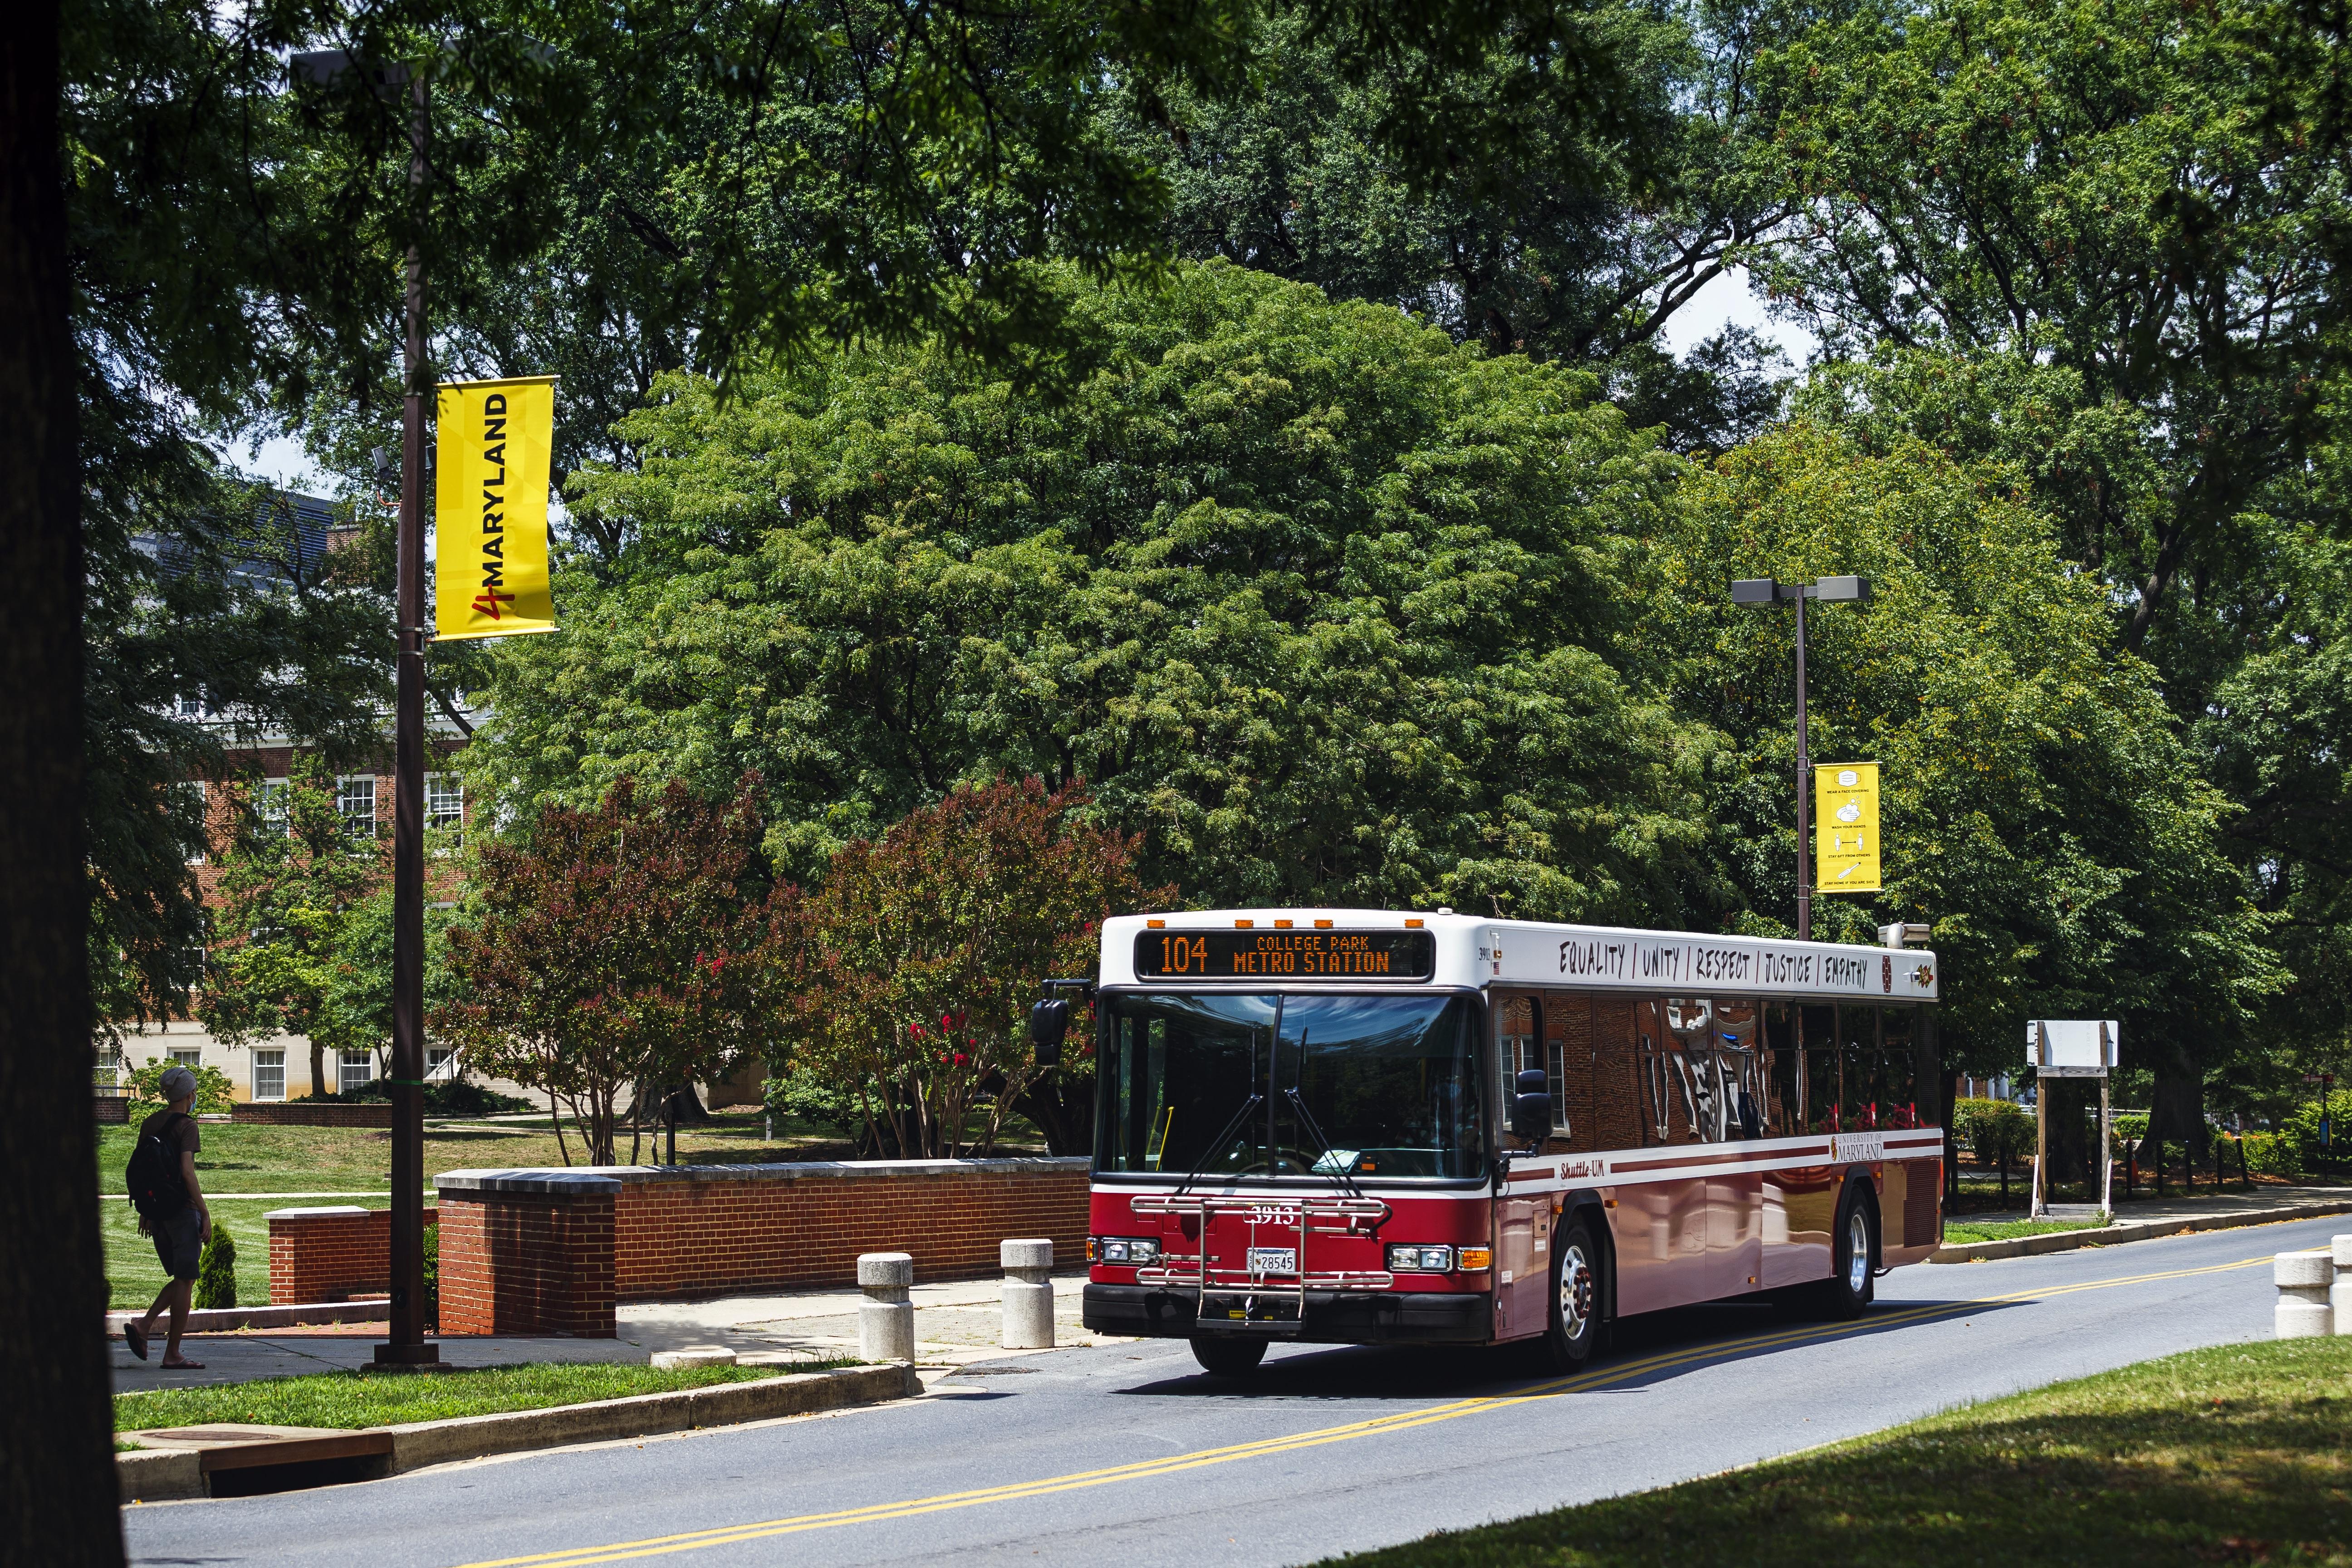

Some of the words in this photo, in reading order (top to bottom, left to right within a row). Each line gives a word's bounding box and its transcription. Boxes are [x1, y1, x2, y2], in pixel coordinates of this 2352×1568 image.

[482, 393, 507, 587] MARYLAND
[472, 583, 515, 621] 4
[1257, 937, 1321, 951] COLLEGE
[1331, 936, 1369, 951] PARK
[1162, 937, 1208, 972] 104
[1234, 952, 1294, 972] METRO
[1304, 952, 1389, 972] STATION
[1559, 941, 1625, 980] EQUALITY
[1643, 942, 1679, 982] UNITY
[1696, 947, 1750, 980] RESPECT
[1765, 953, 1812, 983] JUSTICE
[1825, 956, 1867, 990] EMPATHY
[1838, 1134, 1873, 1144] UNIVERSITY
[1875, 1133, 1882, 1142] OF
[1838, 1143, 1882, 1162] MARYLAND
[1561, 1159, 1605, 1180] Shuttle-UM
[1251, 1206, 1294, 1225] 3913
[1262, 1256, 1293, 1269] 28545
